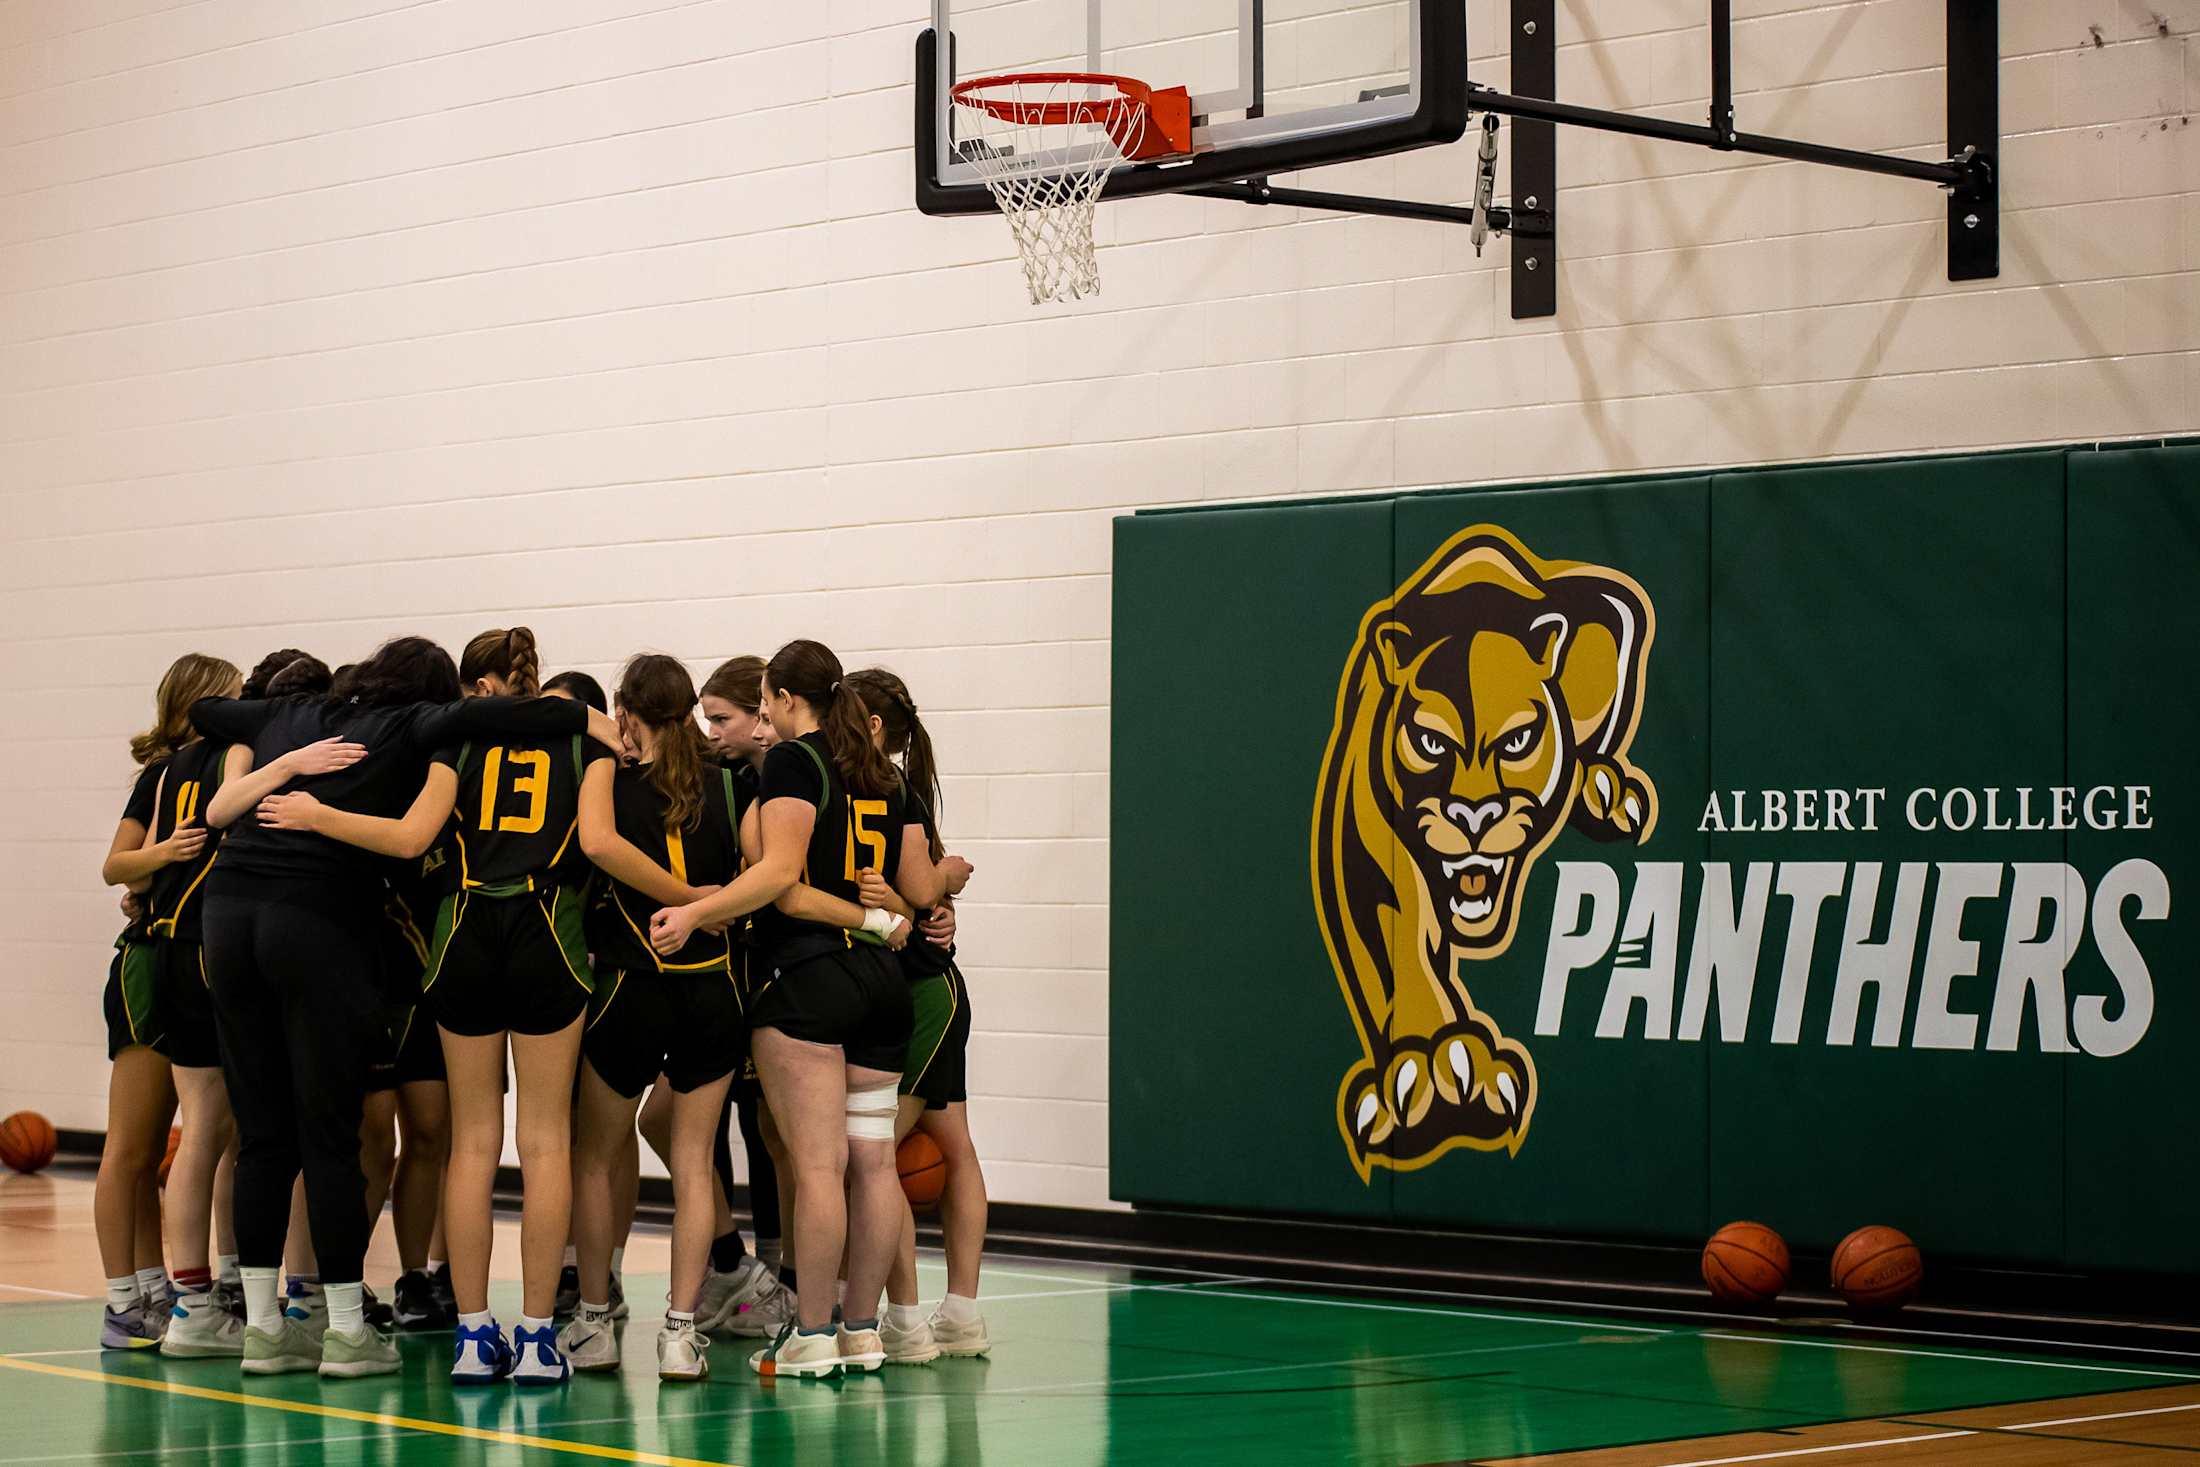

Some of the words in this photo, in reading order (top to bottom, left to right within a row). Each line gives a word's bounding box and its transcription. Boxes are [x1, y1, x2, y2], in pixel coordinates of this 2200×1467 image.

[479, 747, 550, 833] 13
[1697, 788, 1886, 832] ALBERT
[1905, 786, 2153, 831] COLLEGE
[844, 794, 887, 881] 15
[1534, 858, 2171, 1057] PANTHERS
